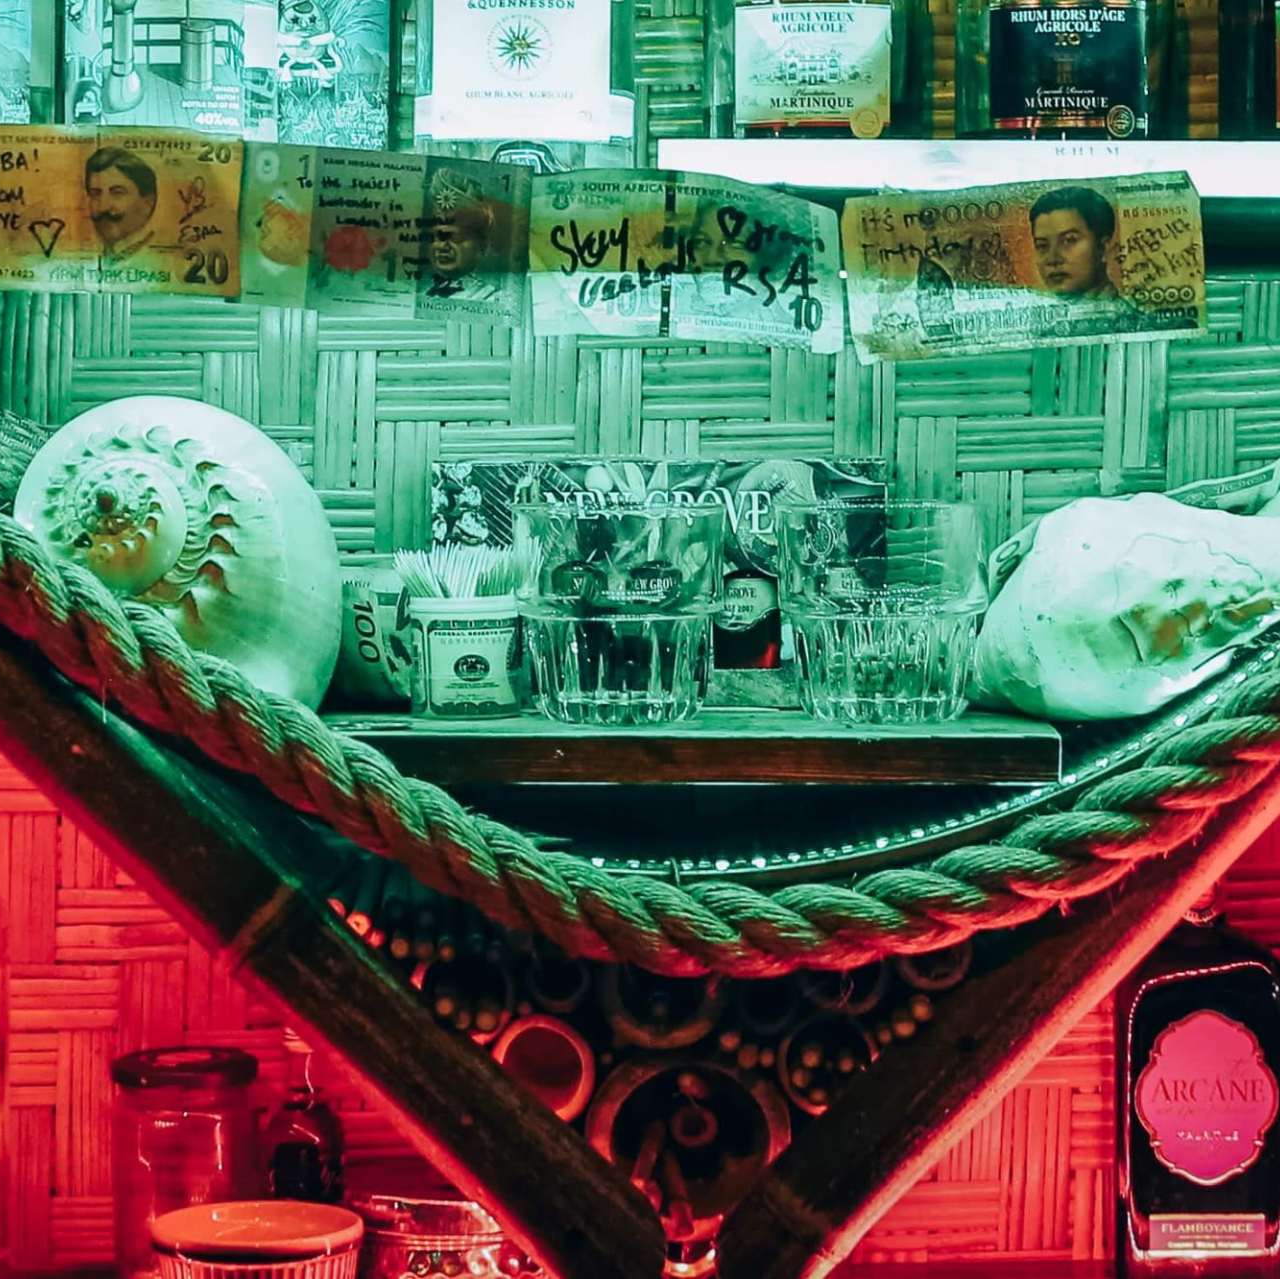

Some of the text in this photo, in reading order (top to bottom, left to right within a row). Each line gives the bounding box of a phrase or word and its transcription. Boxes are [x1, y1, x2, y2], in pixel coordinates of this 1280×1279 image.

[771, 10, 855, 22] RHUM VIEUX
[1010, 10, 1048, 22] RHUM
[1050, 9, 1087, 22] HORS
[779, 22, 848, 33] AGRICOLE
[1034, 21, 1102, 33] AGRICOLE
[770, 96, 855, 109] MARTINIQUE
[1023, 96, 1109, 109] MARTINIQUE
[197, 142, 232, 164] 20
[581, 182, 621, 194] SOUTH
[183, 249, 230, 285] 20
[352, 600, 381, 664] 100
[1152, 1076, 1268, 1105] ARCANE
[1161, 1222, 1255, 1234] FLAMBOYANCE
